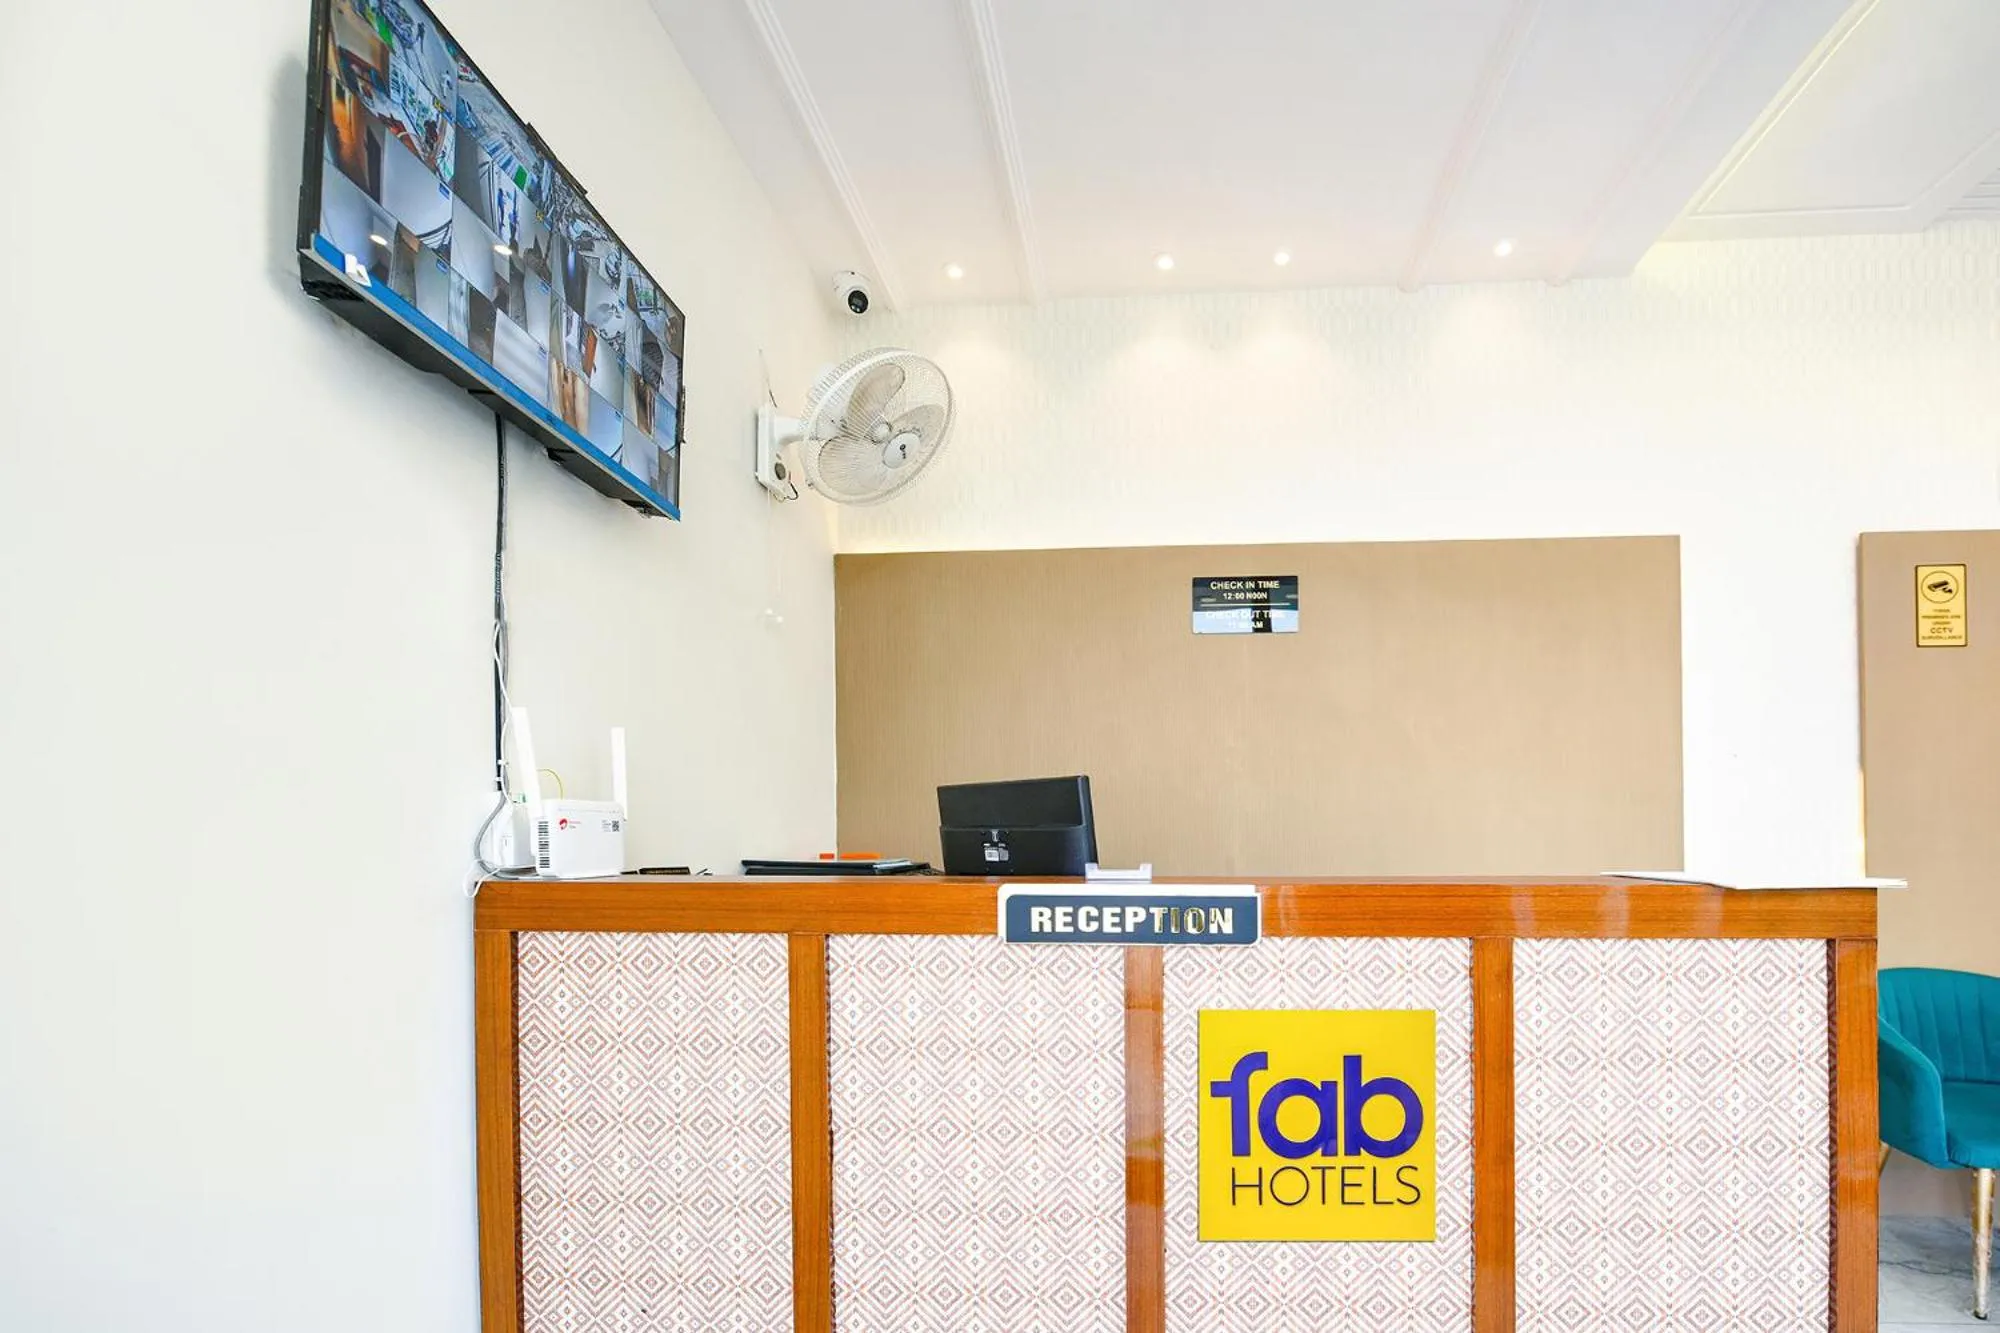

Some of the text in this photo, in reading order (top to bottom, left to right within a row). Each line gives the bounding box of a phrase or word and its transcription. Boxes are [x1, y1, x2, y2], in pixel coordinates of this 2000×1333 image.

[1210, 580, 1280, 590] CHECK IN TIME
[1246, 592, 1268, 600] NOON
[1030, 905, 1234, 934] RECEPTION
[1210, 1051, 1424, 1159] fab
[1231, 1165, 1421, 1206] HOTELS
